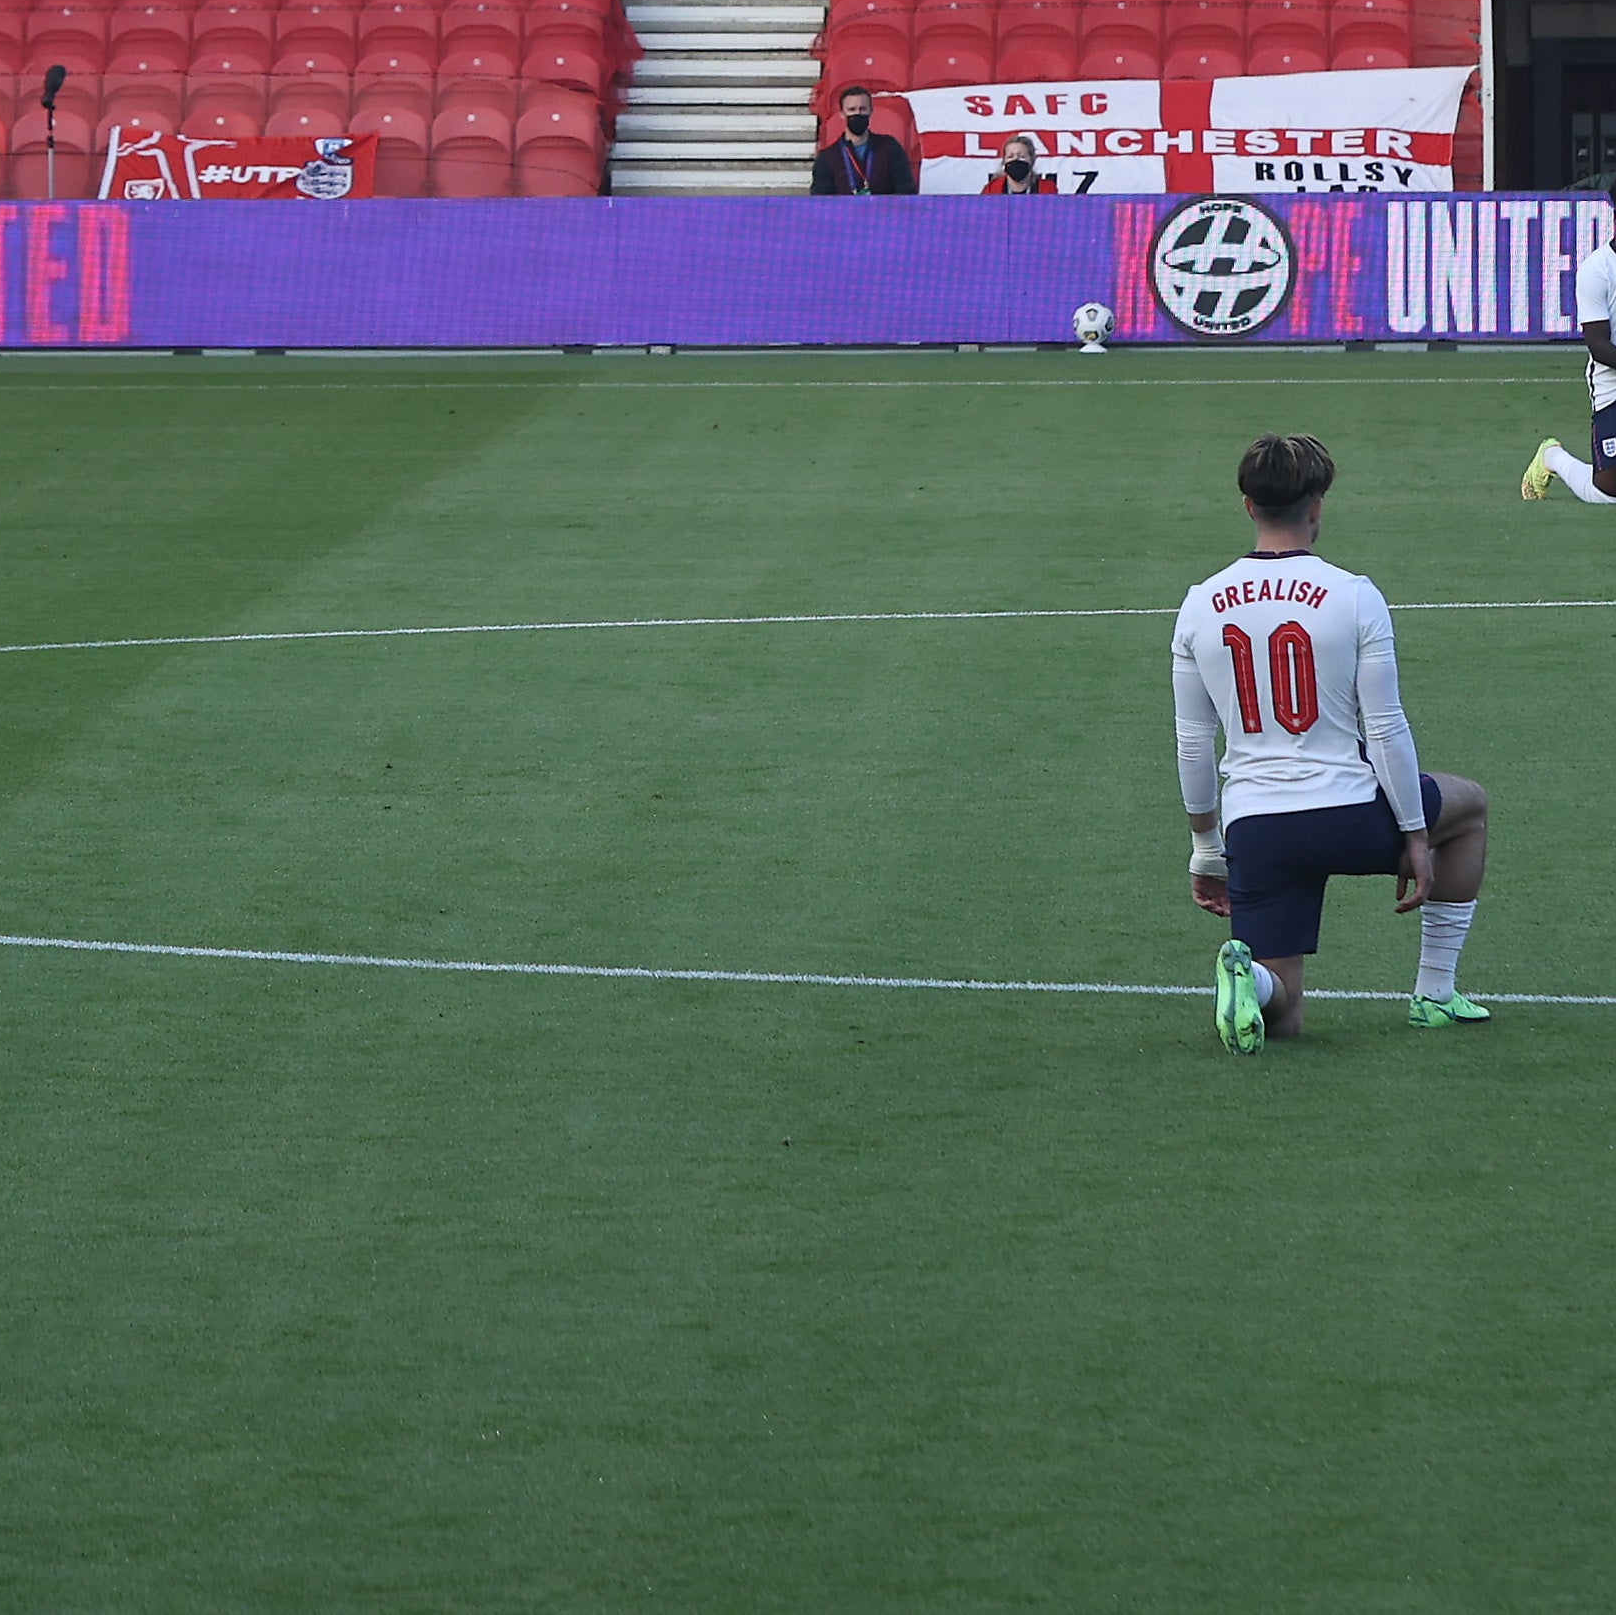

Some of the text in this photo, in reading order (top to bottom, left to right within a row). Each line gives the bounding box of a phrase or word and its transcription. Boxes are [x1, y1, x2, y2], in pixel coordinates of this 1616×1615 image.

[965, 92, 1108, 117] SAFC
[964, 129, 1414, 159] LANCHESTER
[198, 164, 301, 184] #UTP
[1255, 161, 1414, 188] ROLLSY
[1114, 201, 1364, 336] HPE
[1212, 579, 1328, 614] GREALISH
[1222, 621, 1319, 735] 10
